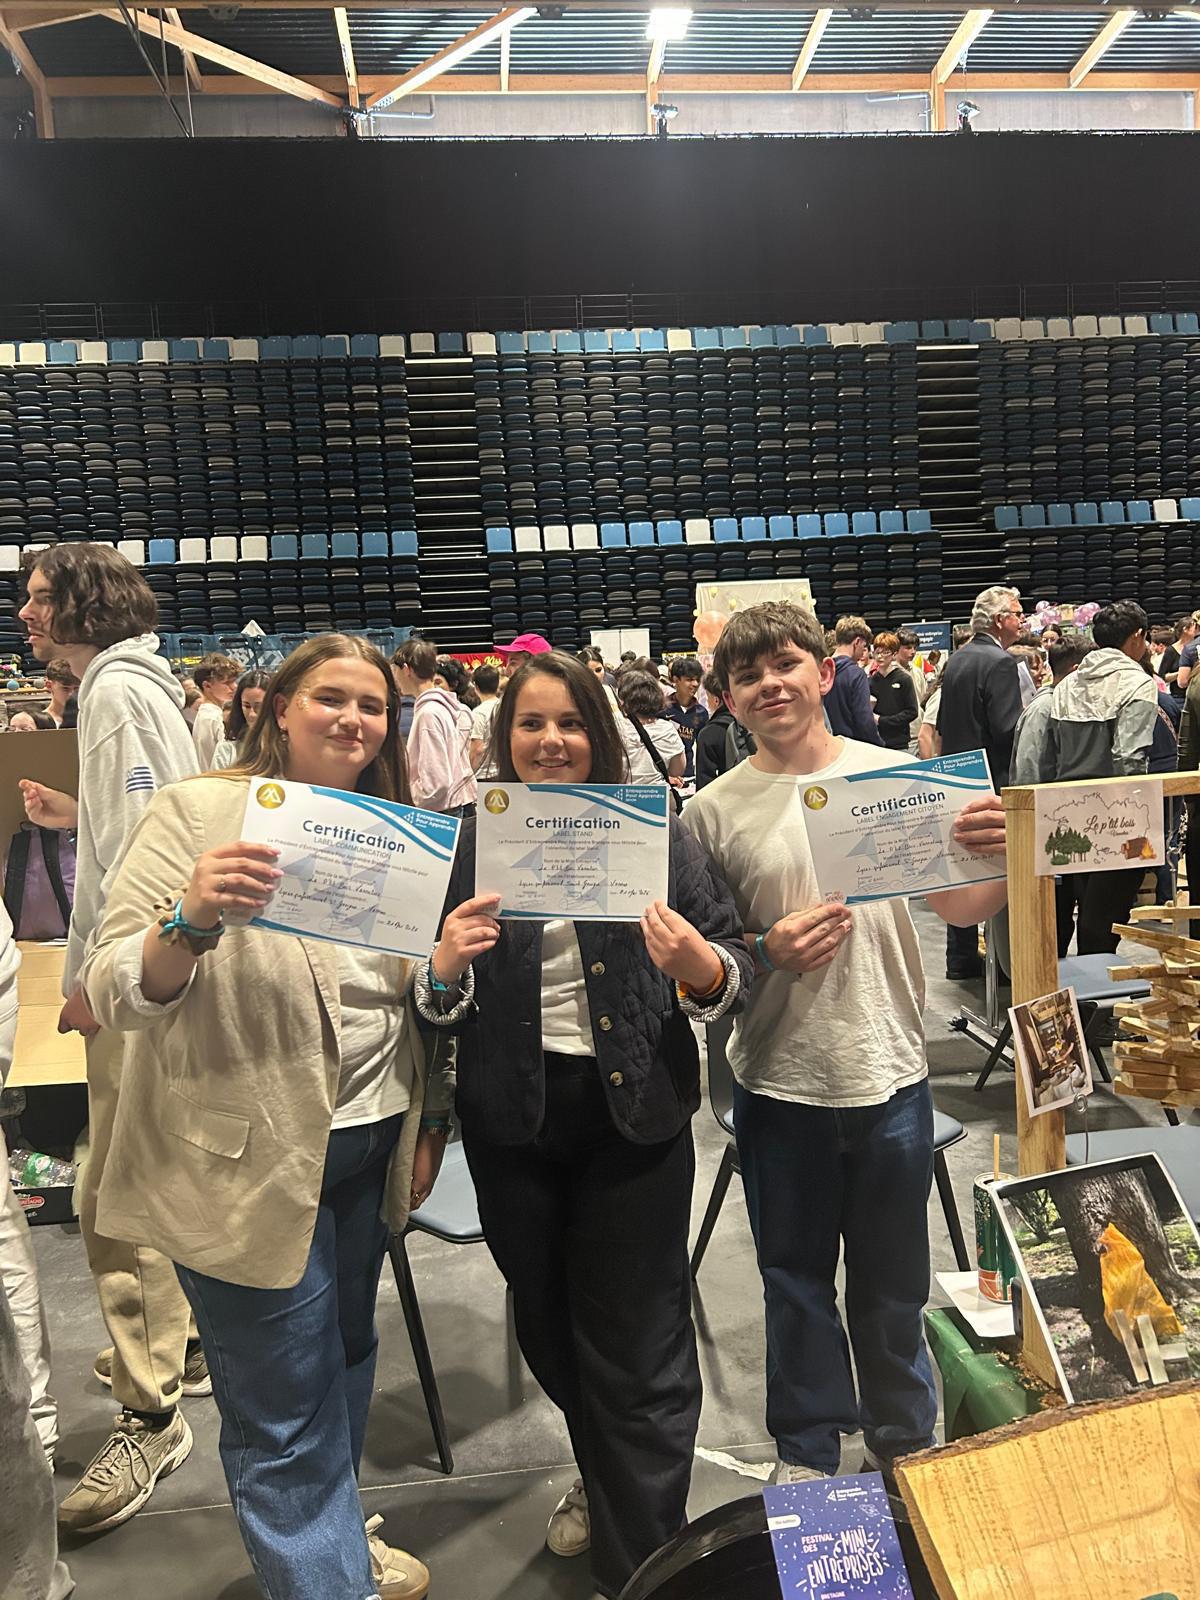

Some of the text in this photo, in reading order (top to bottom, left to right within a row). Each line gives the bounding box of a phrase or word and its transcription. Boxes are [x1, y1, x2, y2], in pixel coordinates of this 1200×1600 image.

[851, 790, 946, 817] Certification
[526, 817, 620, 829] Certification
[857, 816, 875, 824] LABEL
[876, 808, 917, 820] ENGAGEMENT
[918, 804, 944, 813] CITOYEN
[1083, 814, 1098, 835] Le
[303, 820, 405, 854] Certification
[314, 837, 392, 860] LABEL COMMUNICATION
[801, 1533, 835, 1545] FESTIVAL
[803, 1544, 818, 1554] DES
[806, 1548, 884, 1588] ENTREPRISES
[820, 1591, 846, 1600] BRETAGNE
